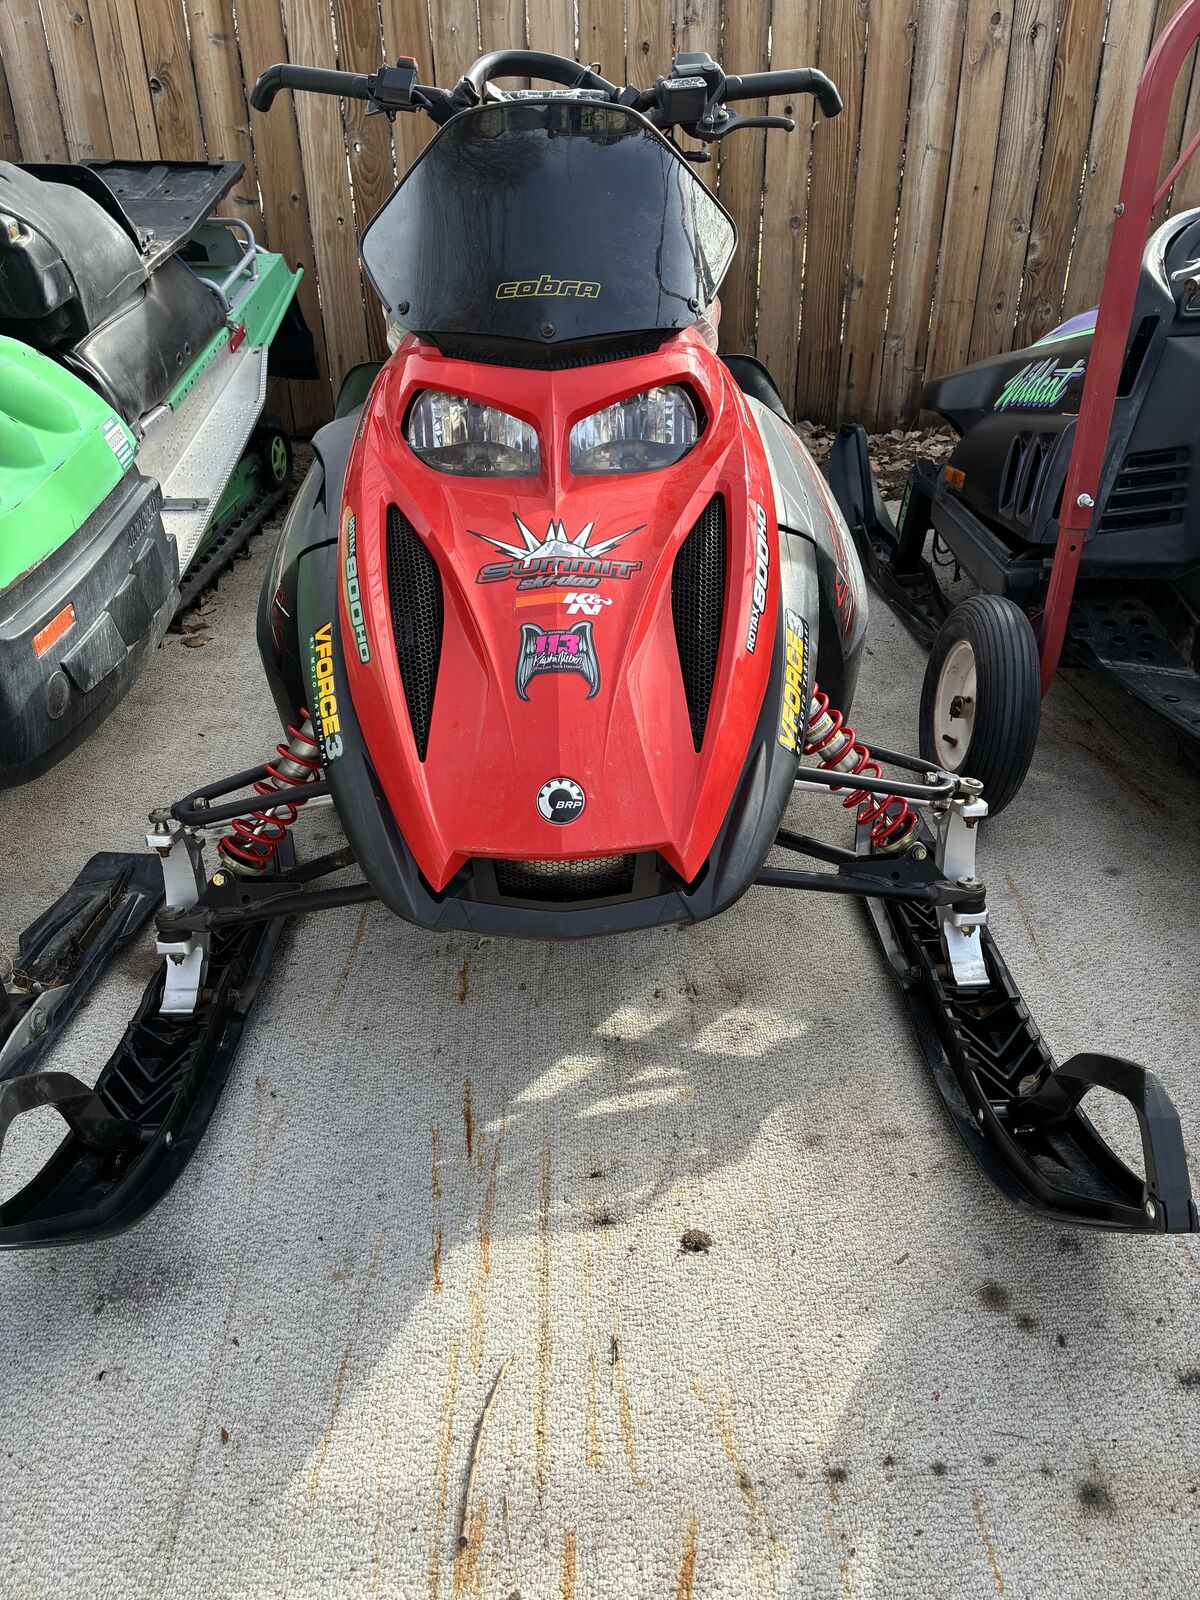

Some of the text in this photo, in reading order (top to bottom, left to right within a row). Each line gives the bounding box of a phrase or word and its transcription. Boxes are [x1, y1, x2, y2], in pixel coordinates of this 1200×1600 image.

[993, 357, 1085, 412] Wildcat
[347, 514, 356, 557] ROTAX
[562, 592, 613, 615] K&N
[535, 634, 580, 655] 113
[746, 606, 760, 654] ROTAX
[799, 694, 807, 729] MOTO
[313, 696, 328, 767] TASSINARI
[555, 801, 582, 809] BRP
